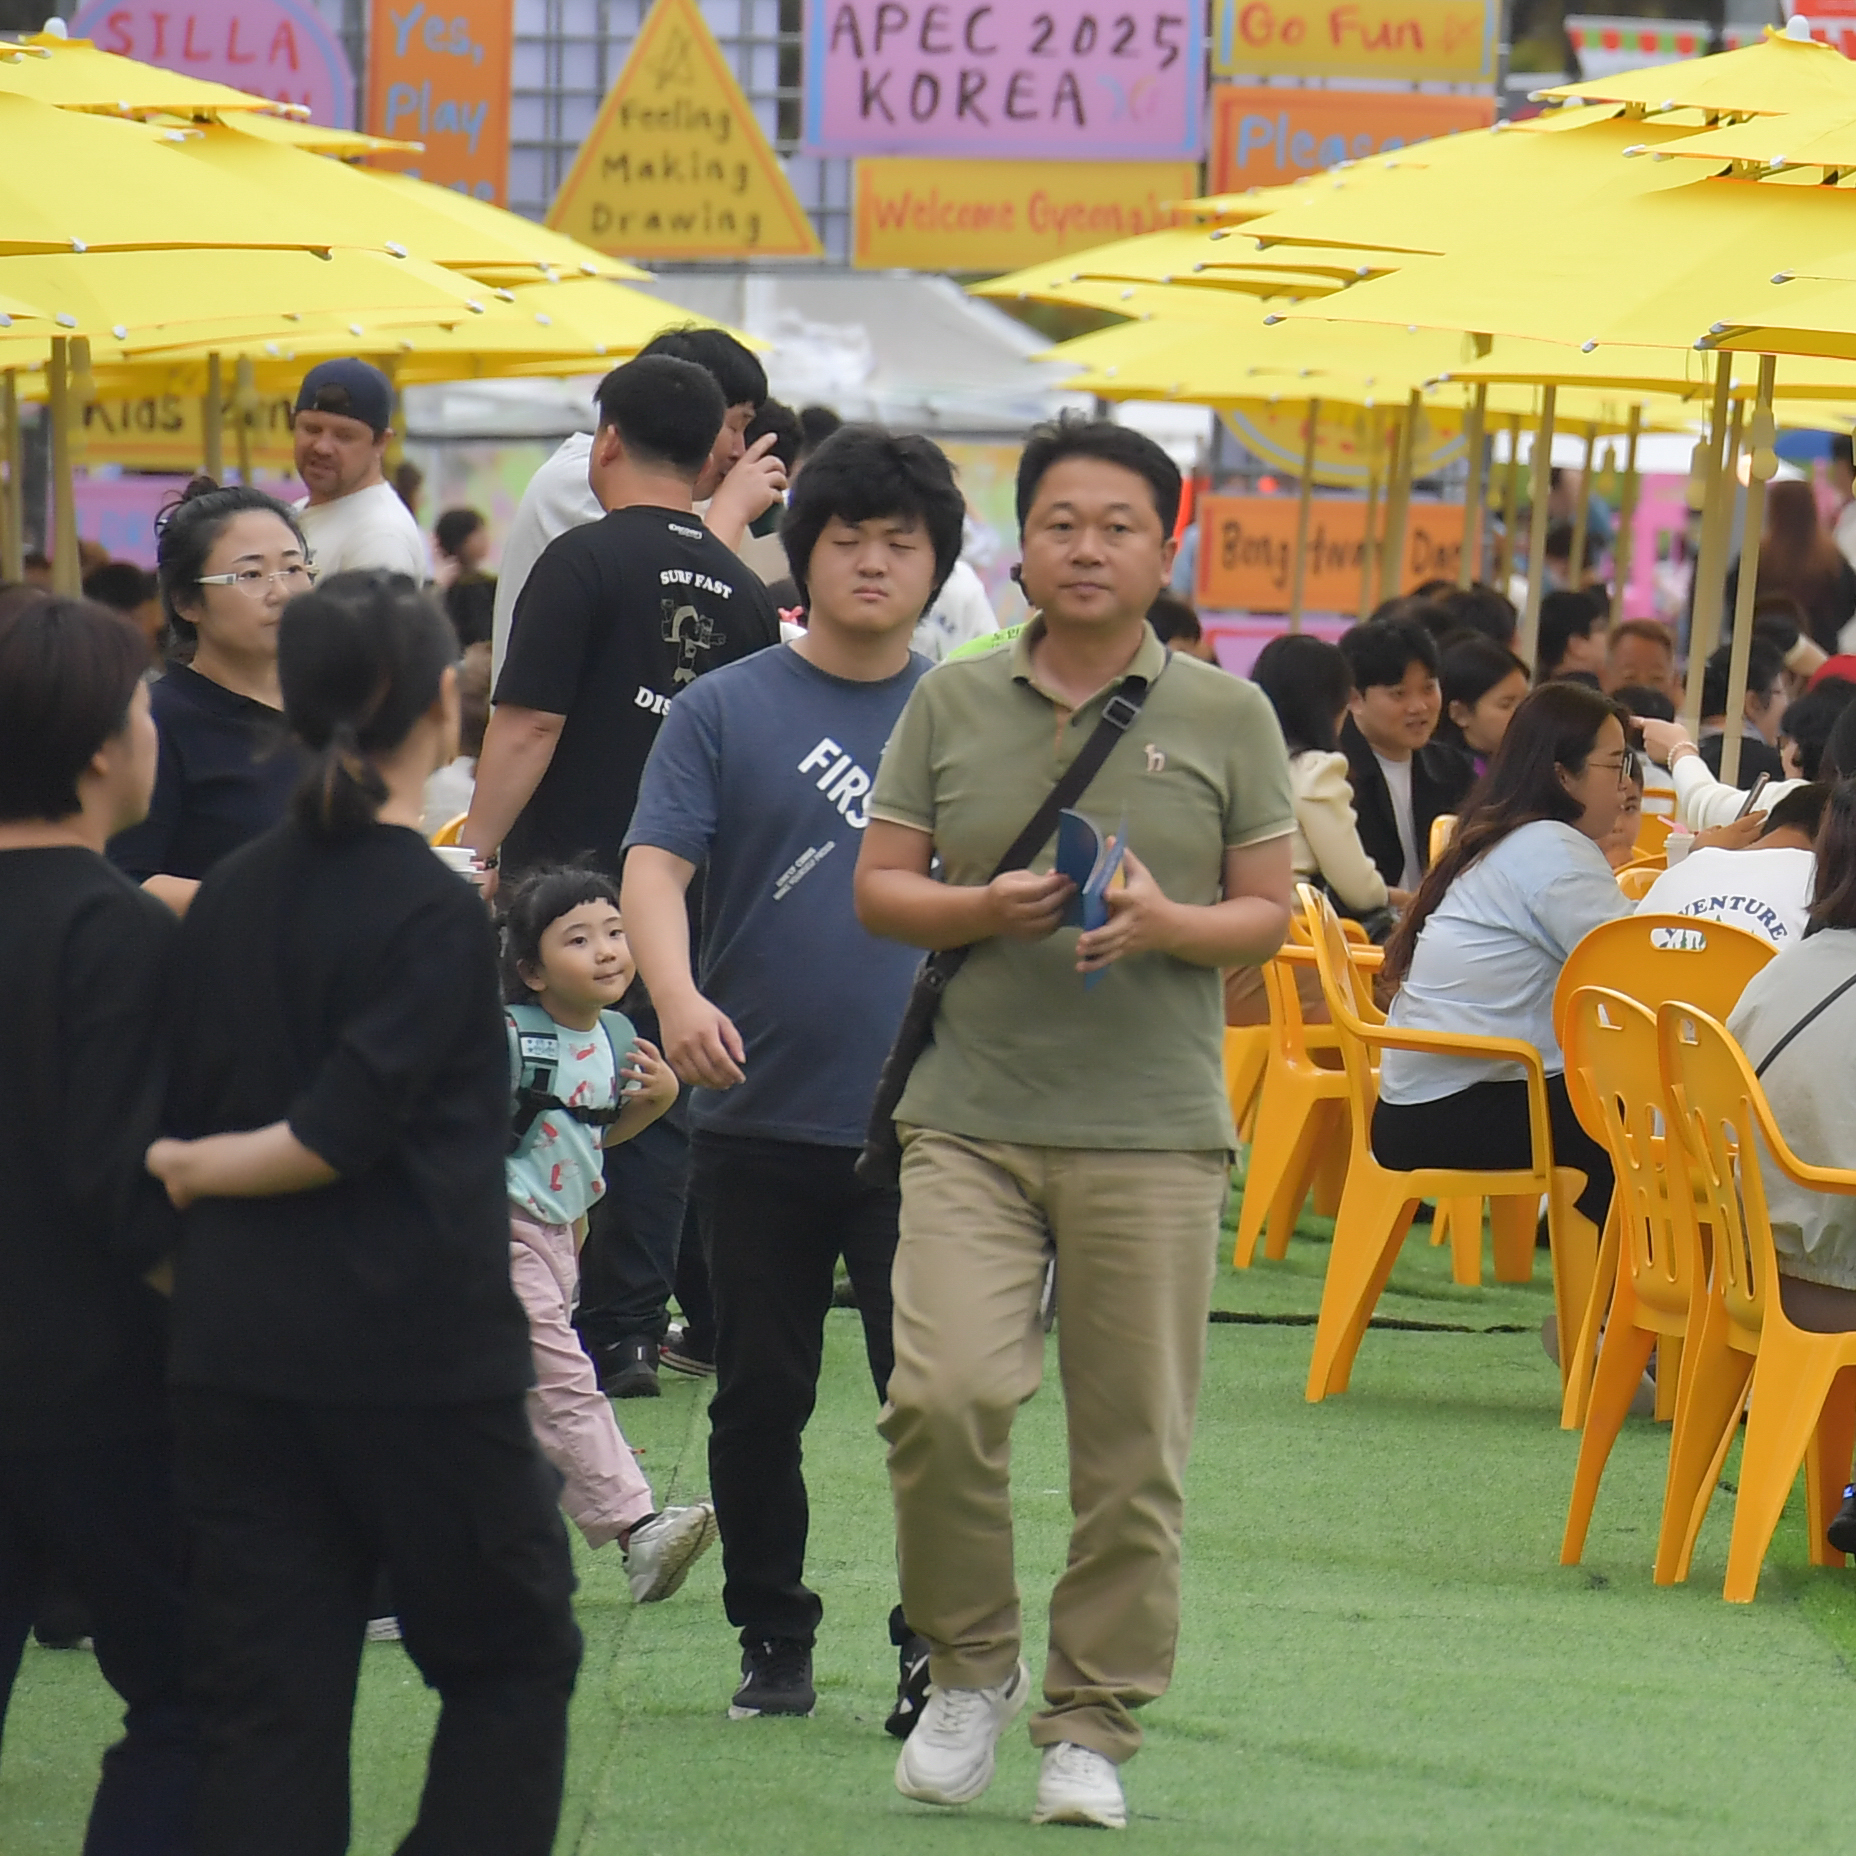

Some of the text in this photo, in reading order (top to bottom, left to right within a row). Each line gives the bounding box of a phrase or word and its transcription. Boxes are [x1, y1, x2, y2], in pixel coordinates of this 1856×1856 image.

[106, 10, 301, 72] SILLA
[389, 2, 483, 66] Yes,
[829, 2, 1185, 70] APEC 2025
[1237, 0, 1426, 53] Go Fun
[386, 80, 487, 154] Play
[858, 69, 1087, 128] KOREA
[601, 151, 750, 196] Making
[591, 203, 762, 259] Drawing
[873, 185, 1014, 233] Welcome
[659, 569, 733, 600] SURF FAST
[797, 737, 873, 829] FIRS
